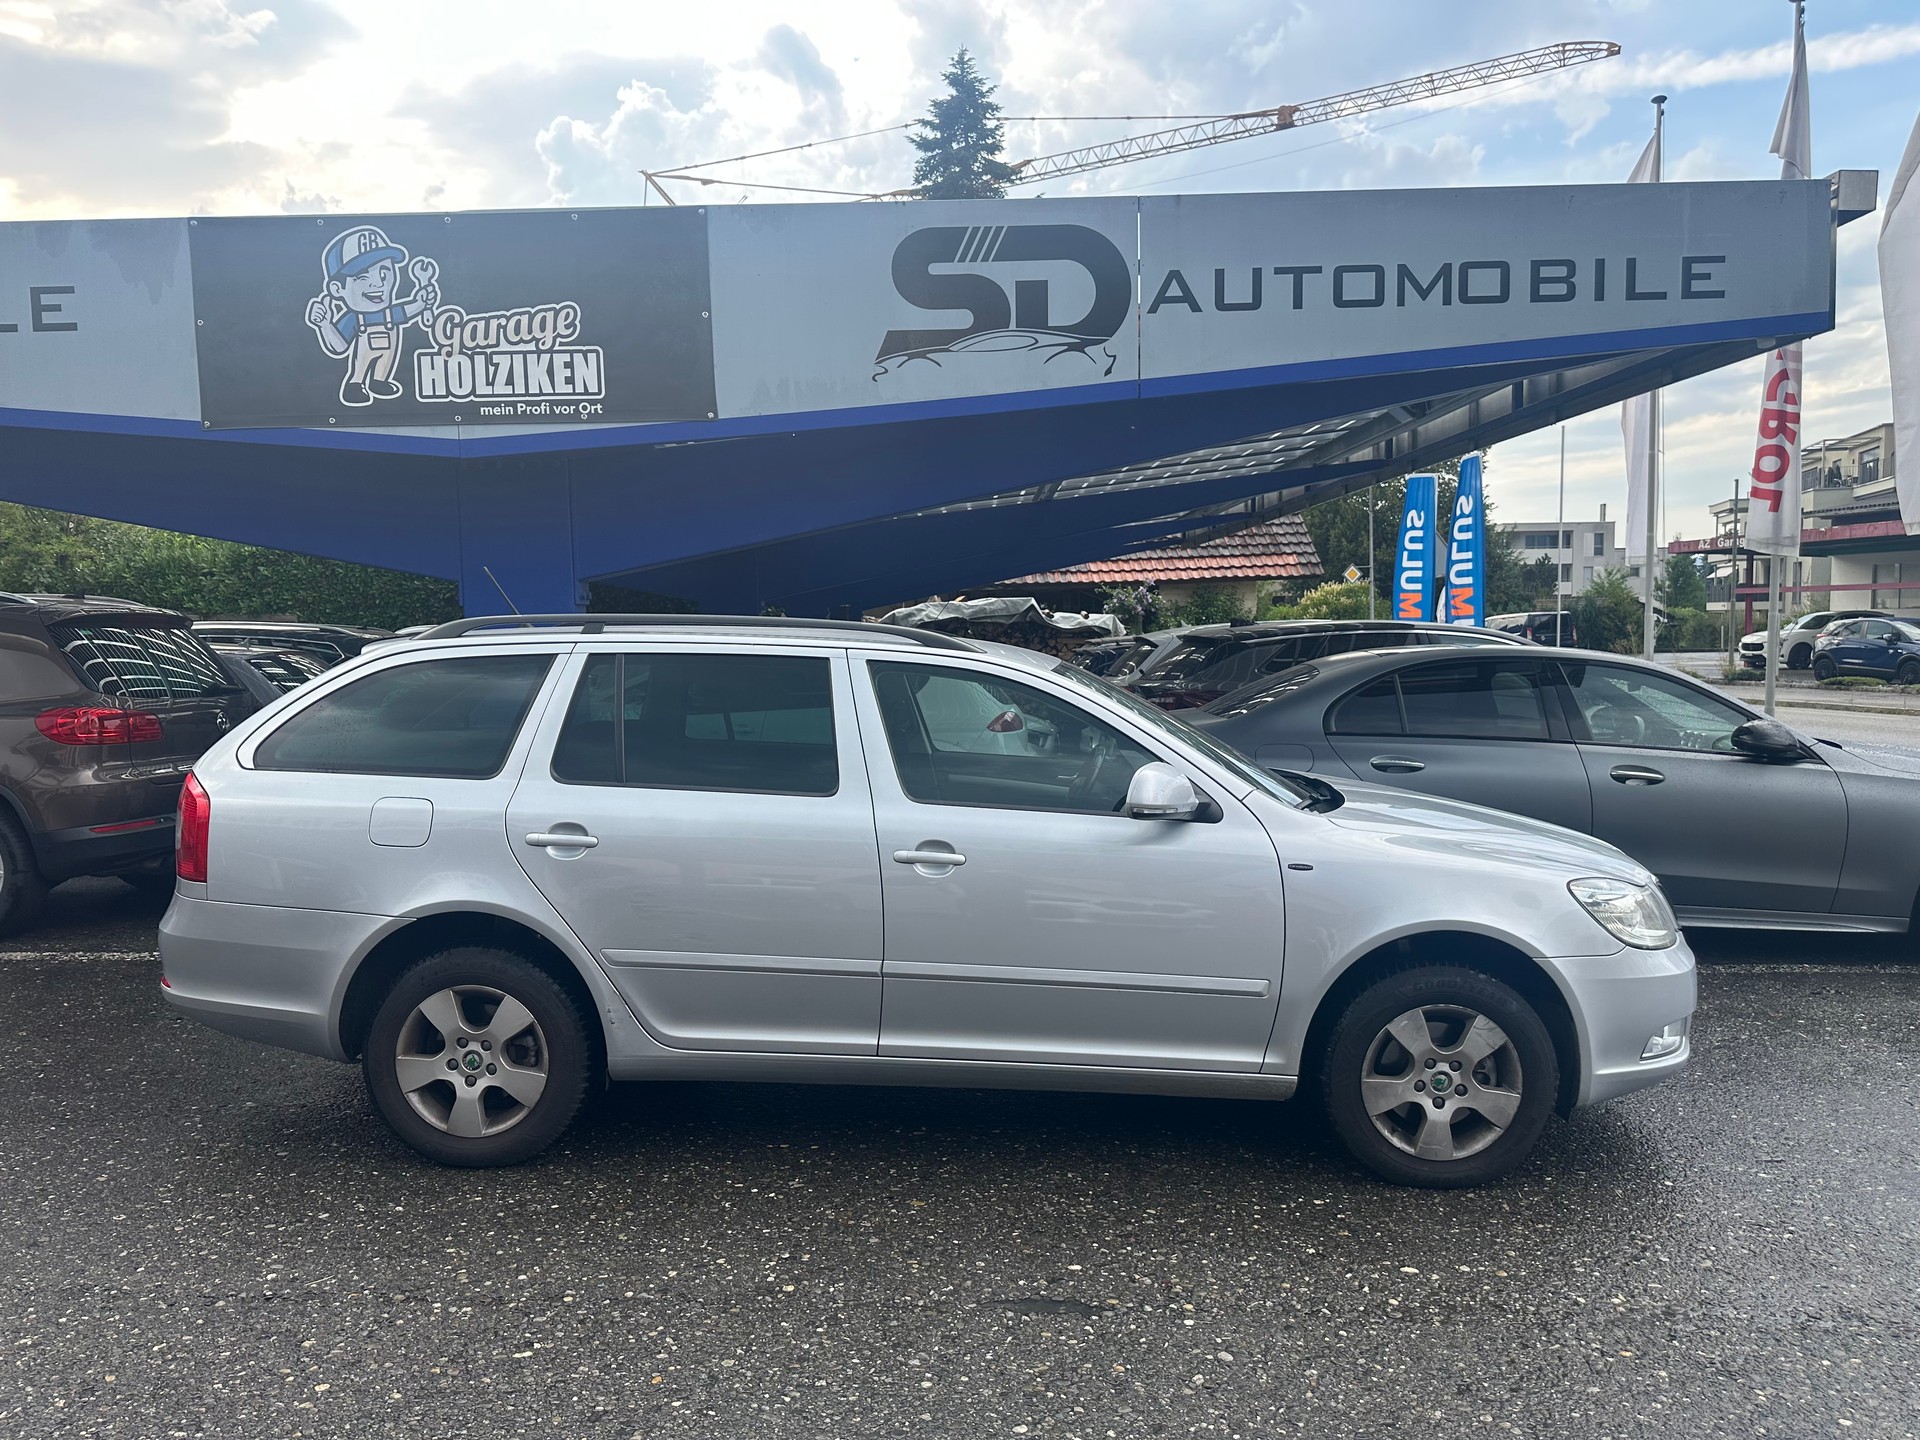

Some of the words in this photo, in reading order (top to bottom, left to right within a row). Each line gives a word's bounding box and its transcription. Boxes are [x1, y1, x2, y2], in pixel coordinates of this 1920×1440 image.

[358, 232, 379, 254] GB
[875, 224, 1132, 364] SD
[1147, 255, 1726, 314] AUTOMOBILE
[435, 308, 575, 361] Garage
[420, 353, 599, 396] HOLZIKEN
[480, 404, 514, 415] mein
[517, 402, 550, 414] Profi
[553, 405, 576, 414] vor
[579, 402, 603, 414] Ort
[1697, 540, 1711, 549] AZ
